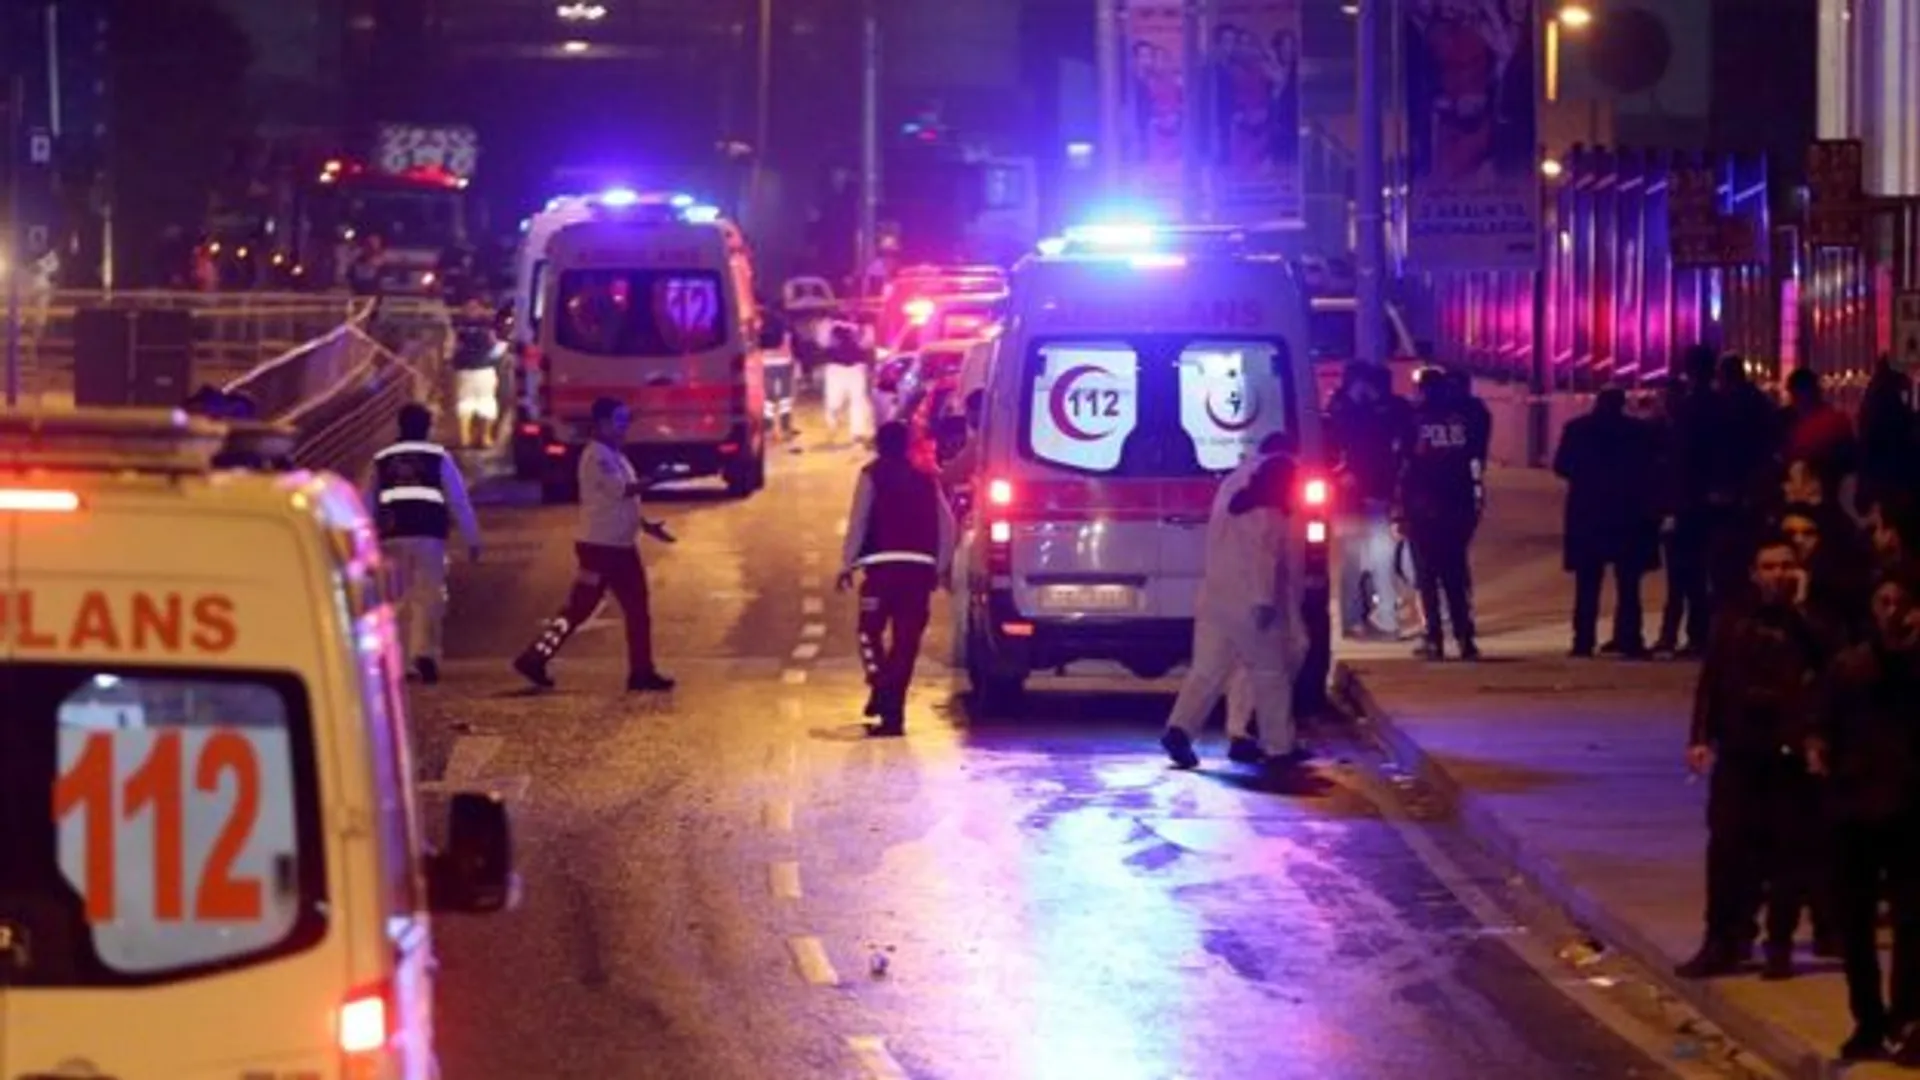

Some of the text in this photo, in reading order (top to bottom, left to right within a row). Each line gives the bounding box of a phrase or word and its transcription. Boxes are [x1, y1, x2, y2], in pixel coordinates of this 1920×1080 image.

[1067, 389, 1121, 418] 112
[0, 589, 239, 653] LANS
[52, 728, 262, 921] 112
